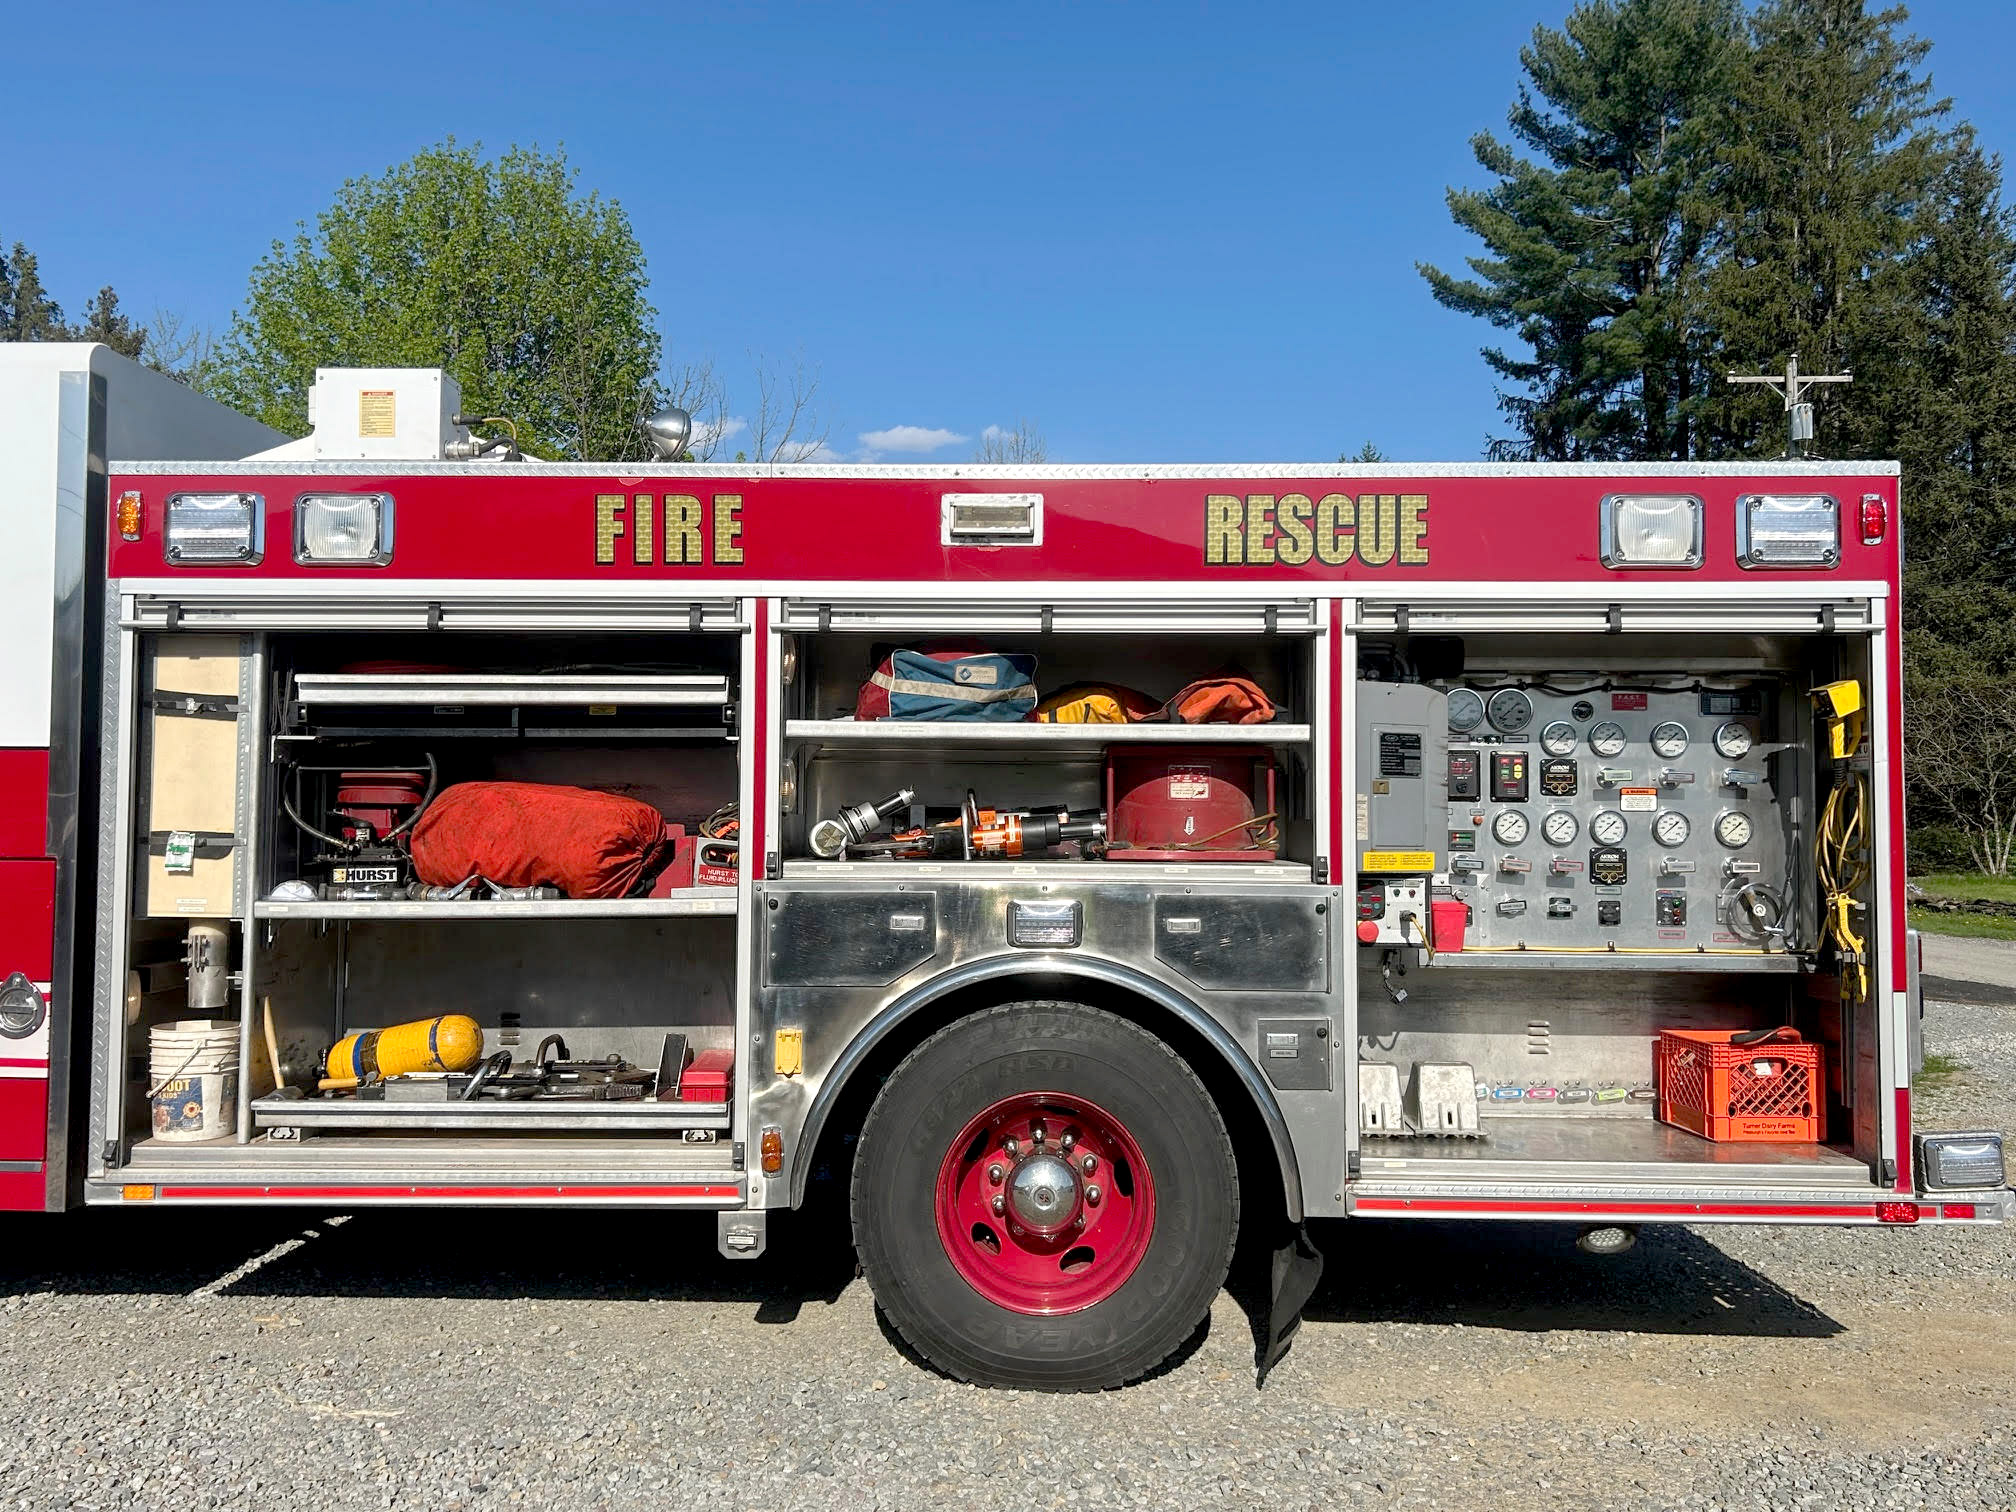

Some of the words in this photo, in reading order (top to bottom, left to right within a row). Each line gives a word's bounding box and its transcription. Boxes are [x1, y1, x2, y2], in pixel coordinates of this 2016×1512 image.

[595, 494, 744, 566] FIRE
[1204, 493, 1428, 567] RESCUE
[347, 869, 396, 881] HURST
[1761, 1122, 1776, 1130] Dairy
